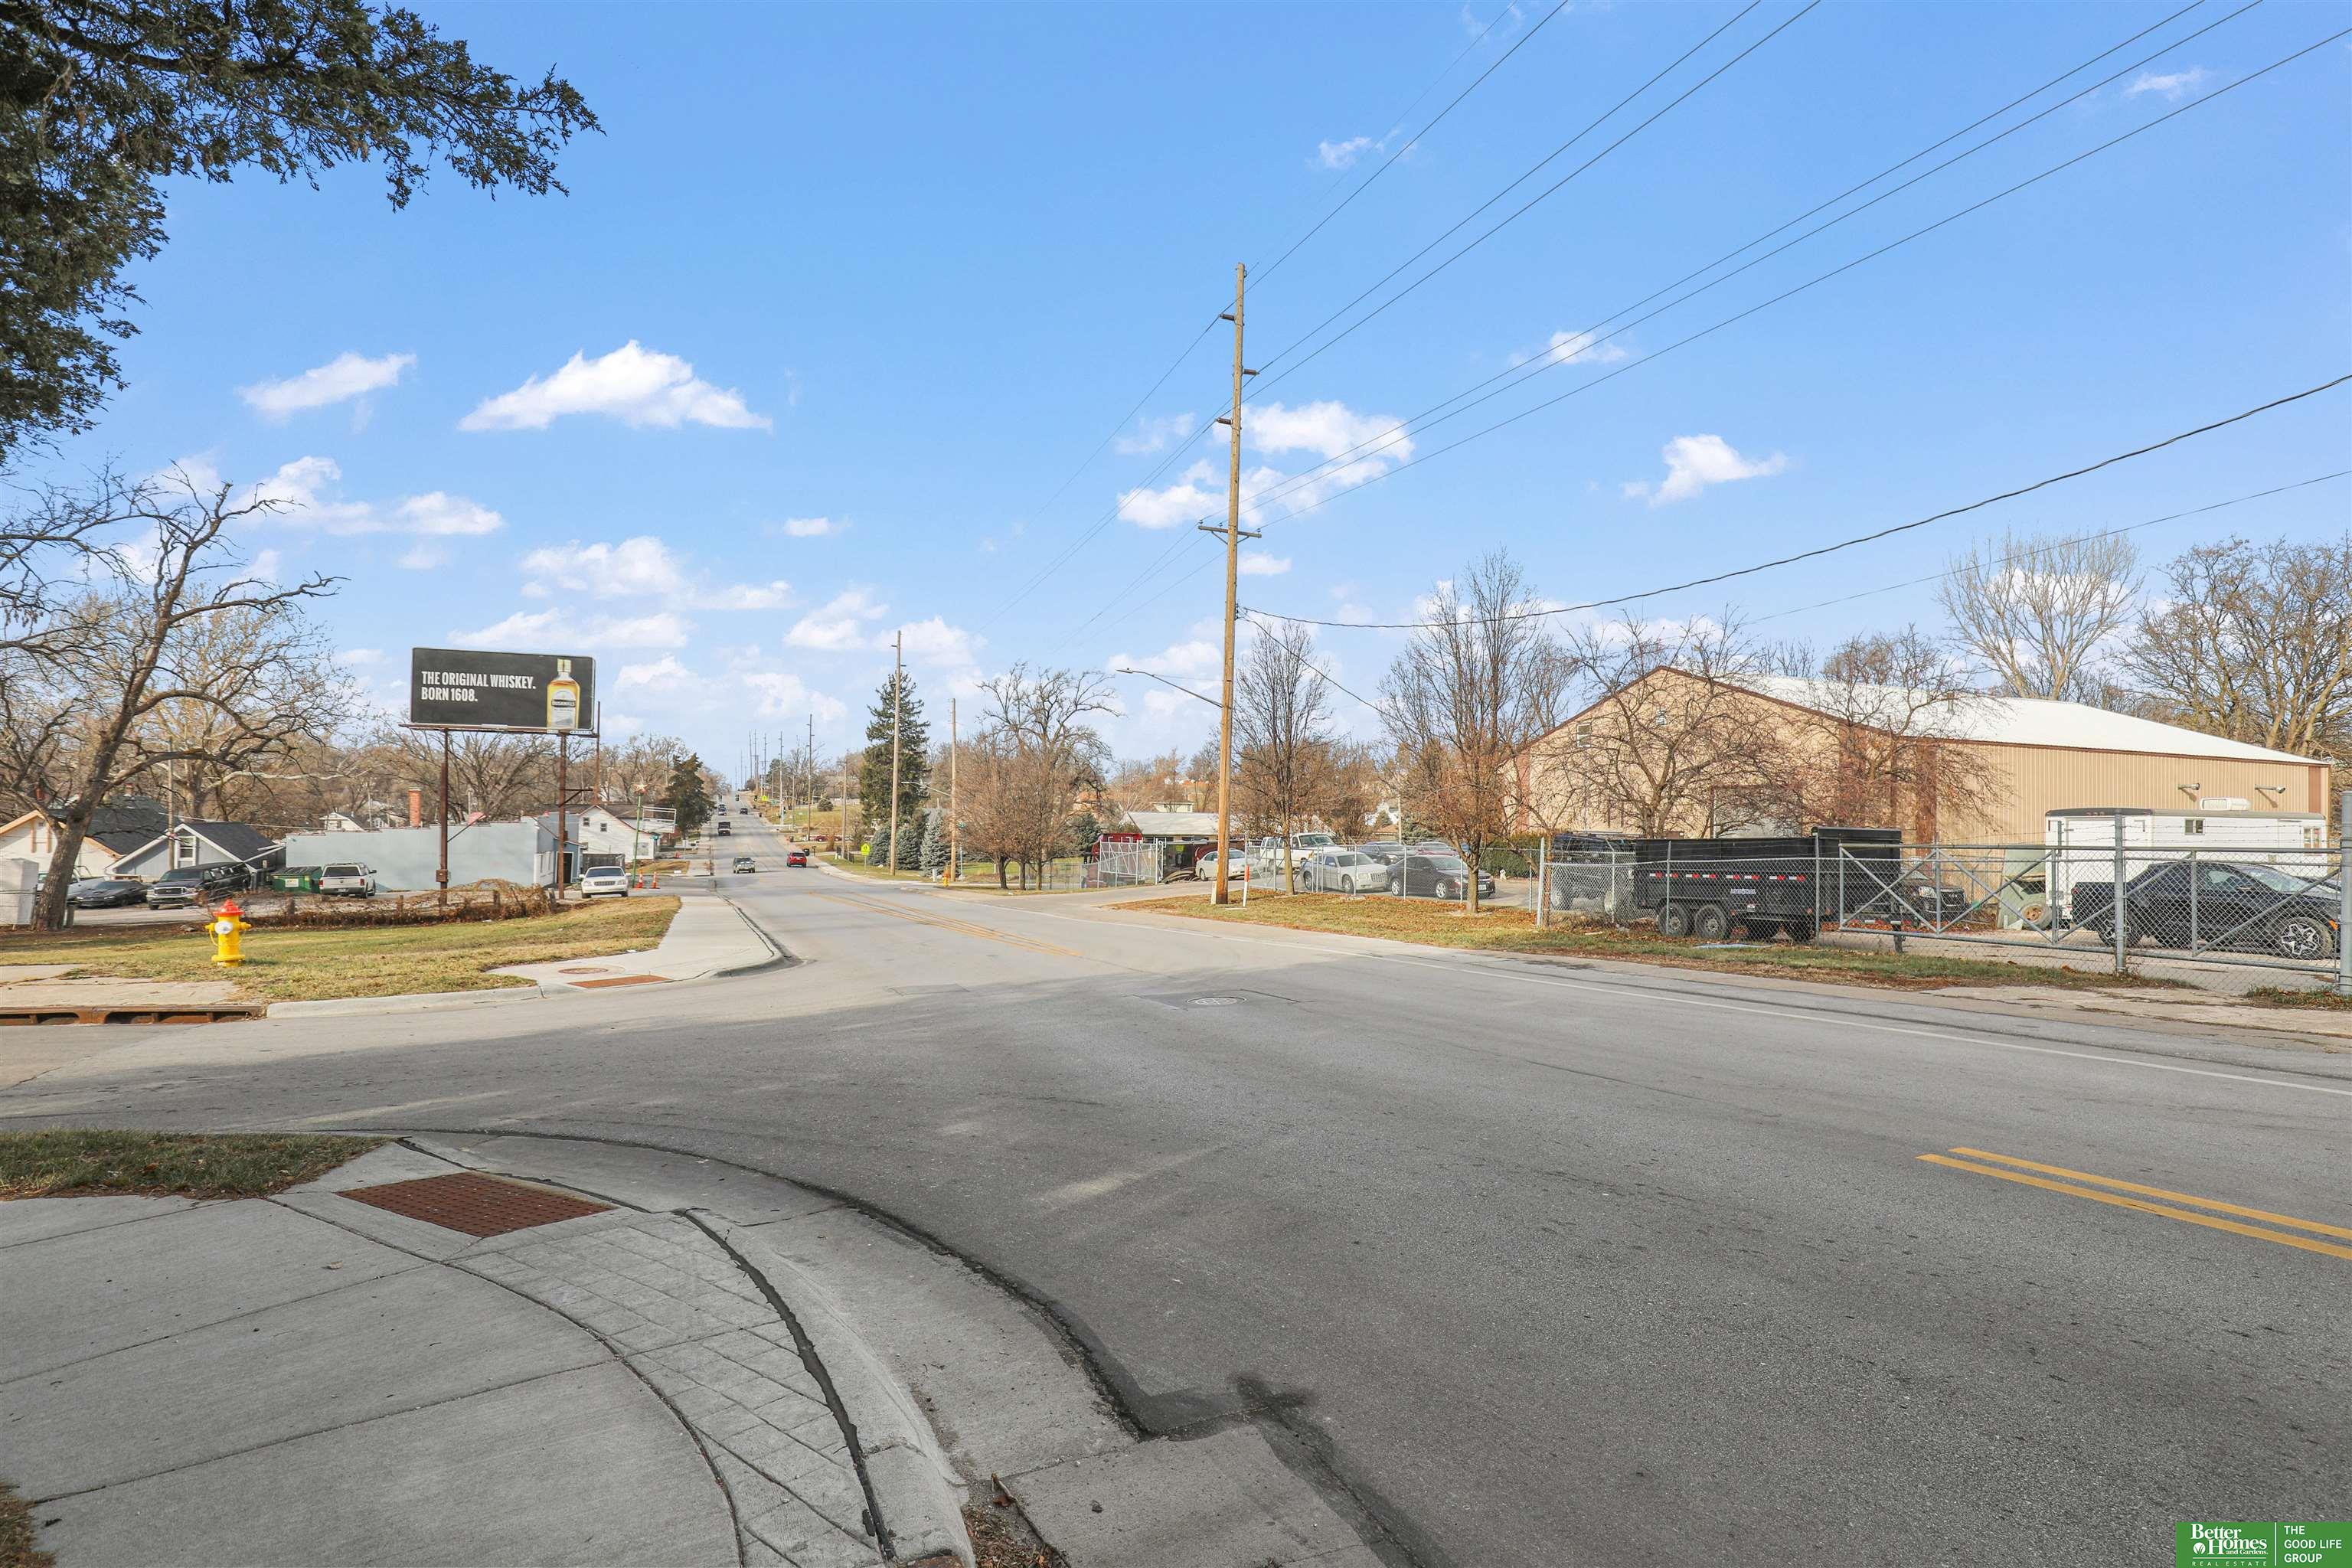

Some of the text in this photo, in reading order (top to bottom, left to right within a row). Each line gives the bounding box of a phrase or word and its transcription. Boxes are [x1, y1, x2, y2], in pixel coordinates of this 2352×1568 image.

[421, 671, 537, 689] THE ORIGINAL WHISKEY.
[421, 687, 478, 702] BORN 1608.
